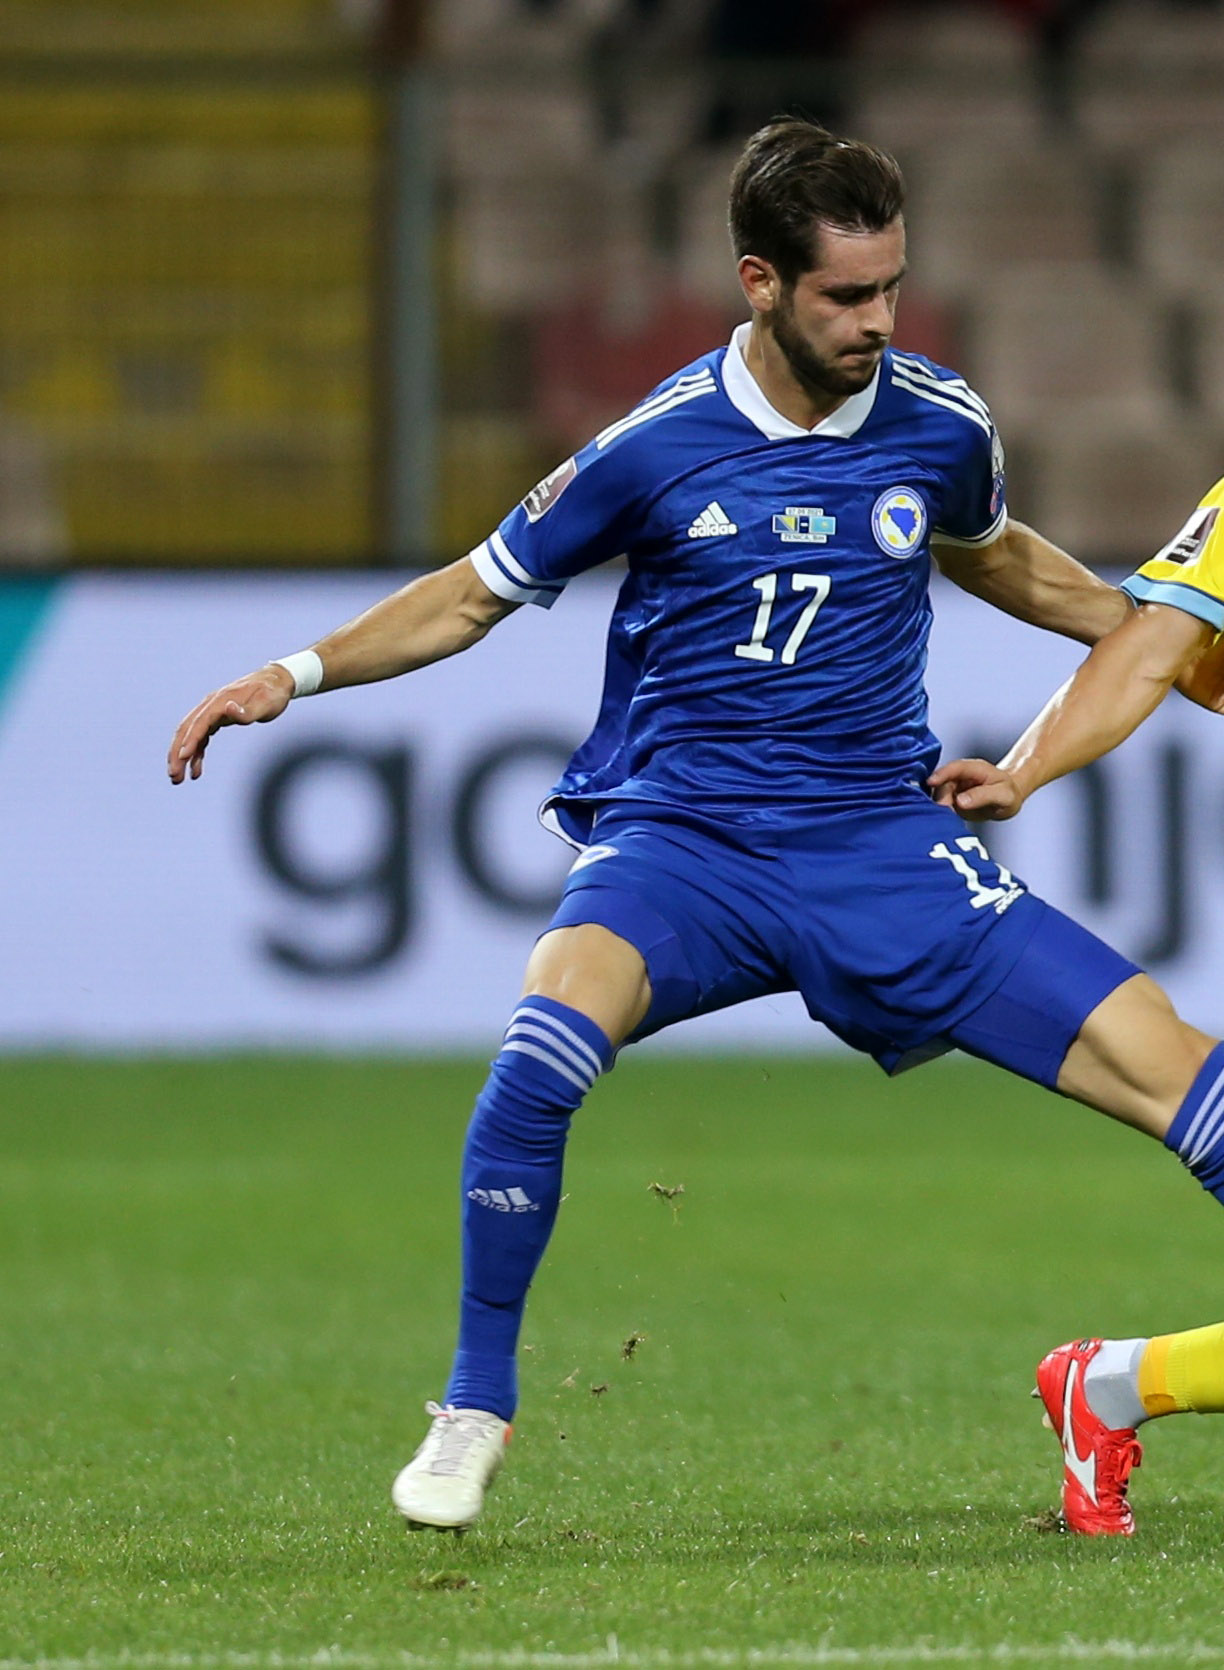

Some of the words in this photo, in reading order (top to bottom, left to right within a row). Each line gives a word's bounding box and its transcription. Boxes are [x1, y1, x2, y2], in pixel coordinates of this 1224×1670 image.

[687, 523, 738, 539] adidas
[735, 573, 831, 664] 17
[929, 836, 1018, 909] 17
[467, 1190, 540, 1212] adidas
